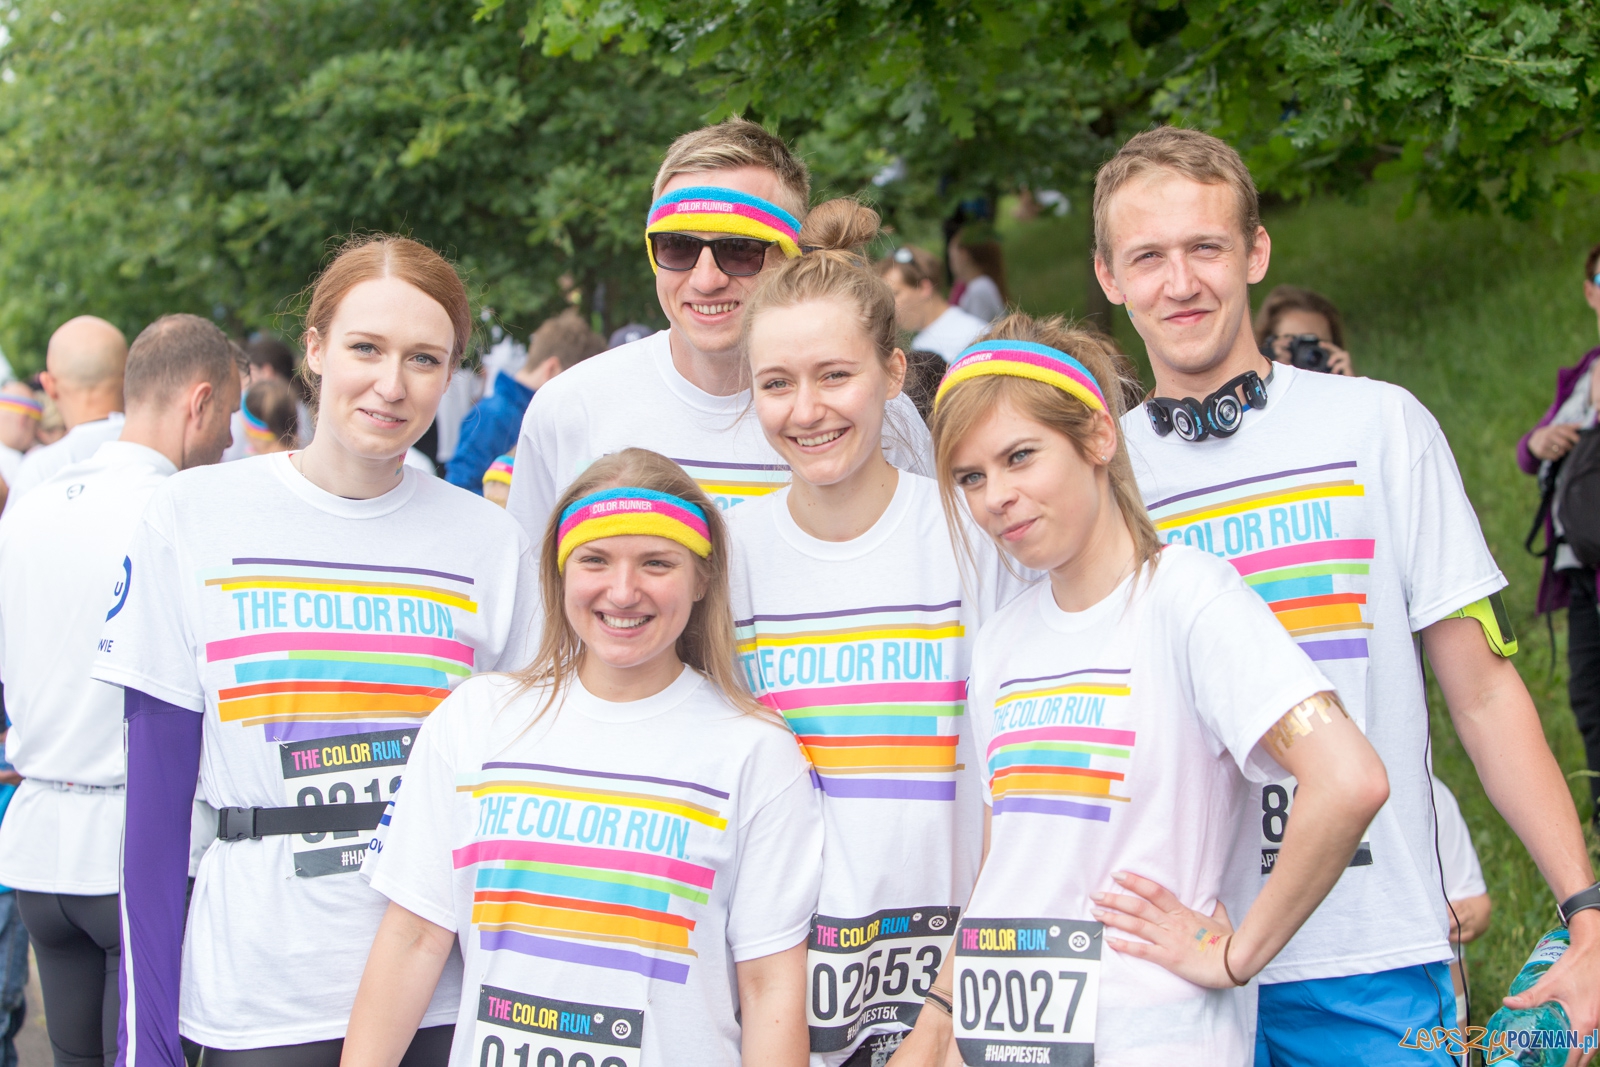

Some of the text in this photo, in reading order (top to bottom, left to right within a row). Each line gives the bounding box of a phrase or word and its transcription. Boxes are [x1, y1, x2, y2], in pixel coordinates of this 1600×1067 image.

[677, 202, 732, 213] COLOR RUNNER
[592, 501, 652, 514] COLOR RUNNER
[232, 591, 288, 630] THE
[294, 592, 393, 632] COLOR
[778, 643, 875, 686] COLOR
[991, 703, 1012, 736] THE
[1009, 697, 1063, 731] COLOR
[291, 748, 321, 771] THE
[322, 742, 371, 767] COLOR
[475, 796, 517, 837] THE
[516, 798, 622, 845] COLOR
[817, 924, 838, 947] THE
[840, 919, 881, 948] COLOR
[962, 928, 979, 950] THE
[979, 928, 1016, 951] COLOR
[488, 995, 512, 1021] THE
[512, 1002, 558, 1031] COLOR
[960, 968, 1087, 1034] 02027
[985, 1044, 1050, 1064] #HAPPIEST5K
